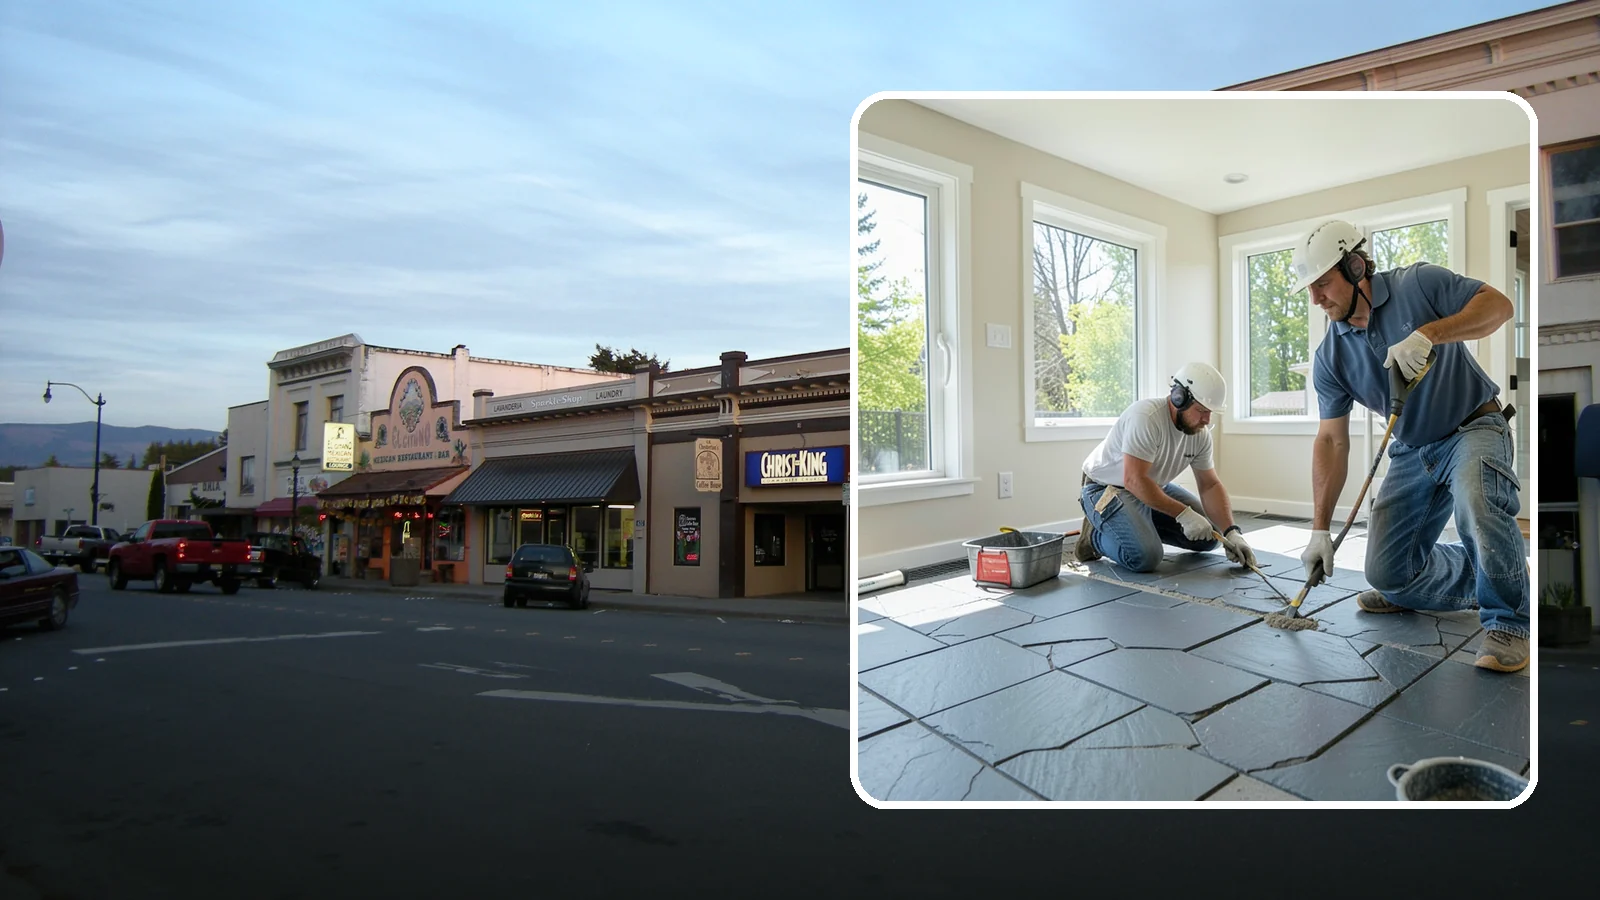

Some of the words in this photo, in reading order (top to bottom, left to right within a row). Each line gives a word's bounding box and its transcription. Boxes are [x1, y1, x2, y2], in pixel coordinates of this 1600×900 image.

[595, 389, 624, 400] LAUNDRY
[494, 402, 523, 413] LAVANDERIA
[530, 397, 560, 409] Sparkle
[562, 395, 583, 405] Shop
[373, 455, 397, 464] MEXICAN
[397, 452, 433, 463] RESTAURANT
[438, 450, 450, 459] BAR
[761, 453, 797, 477] CHRIST
[799, 450, 827, 476] KING
[696, 481, 709, 489] Coffee
